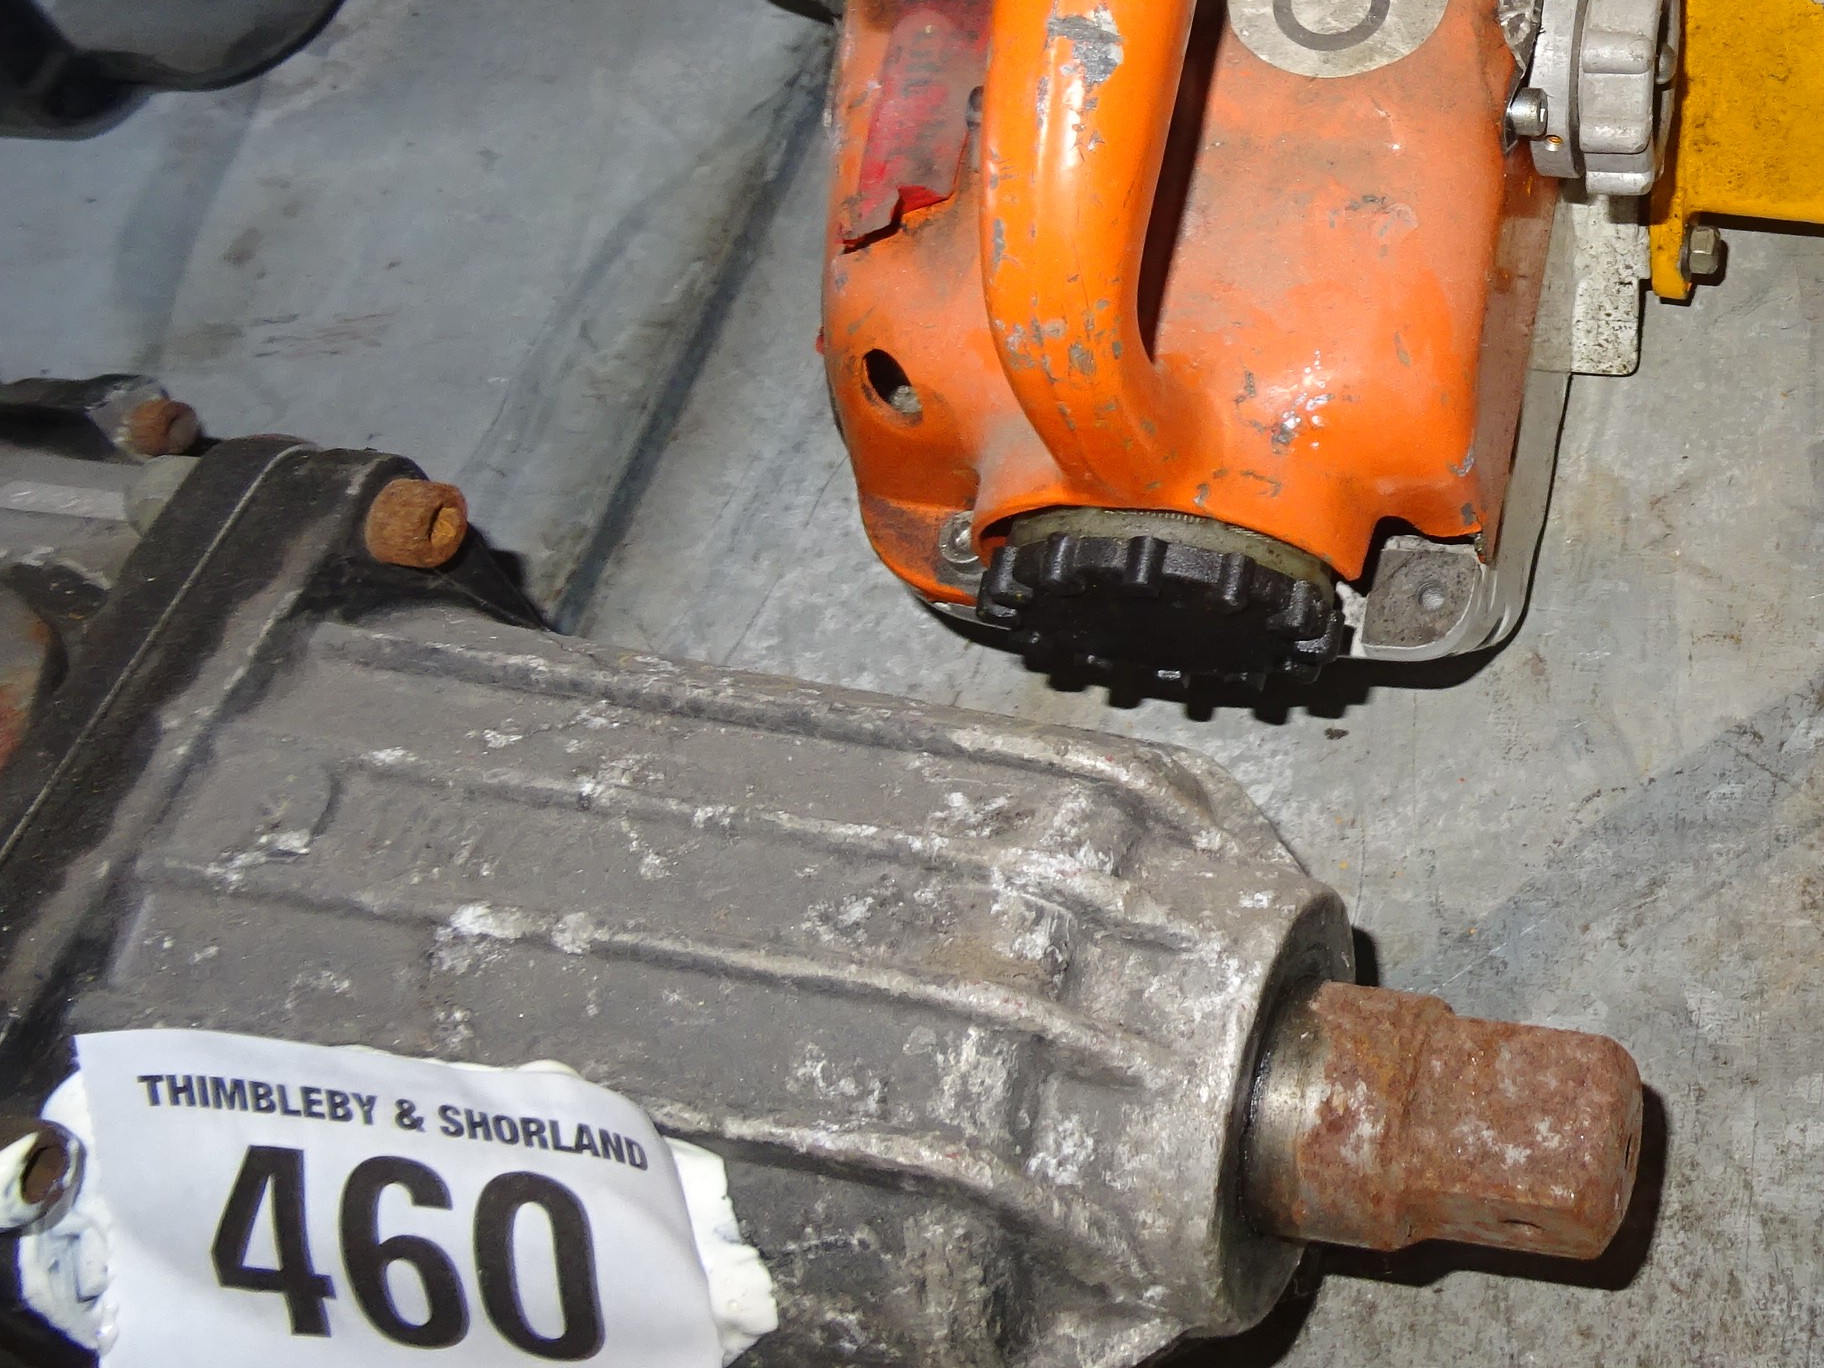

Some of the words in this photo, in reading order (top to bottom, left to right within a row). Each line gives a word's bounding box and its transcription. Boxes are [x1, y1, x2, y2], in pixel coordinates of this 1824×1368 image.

[136, 1074, 379, 1126] THIMBLEBY
[395, 1098, 425, 1132] &
[440, 1103, 649, 1172] SHORLAND
[210, 1144, 606, 1362] 460
